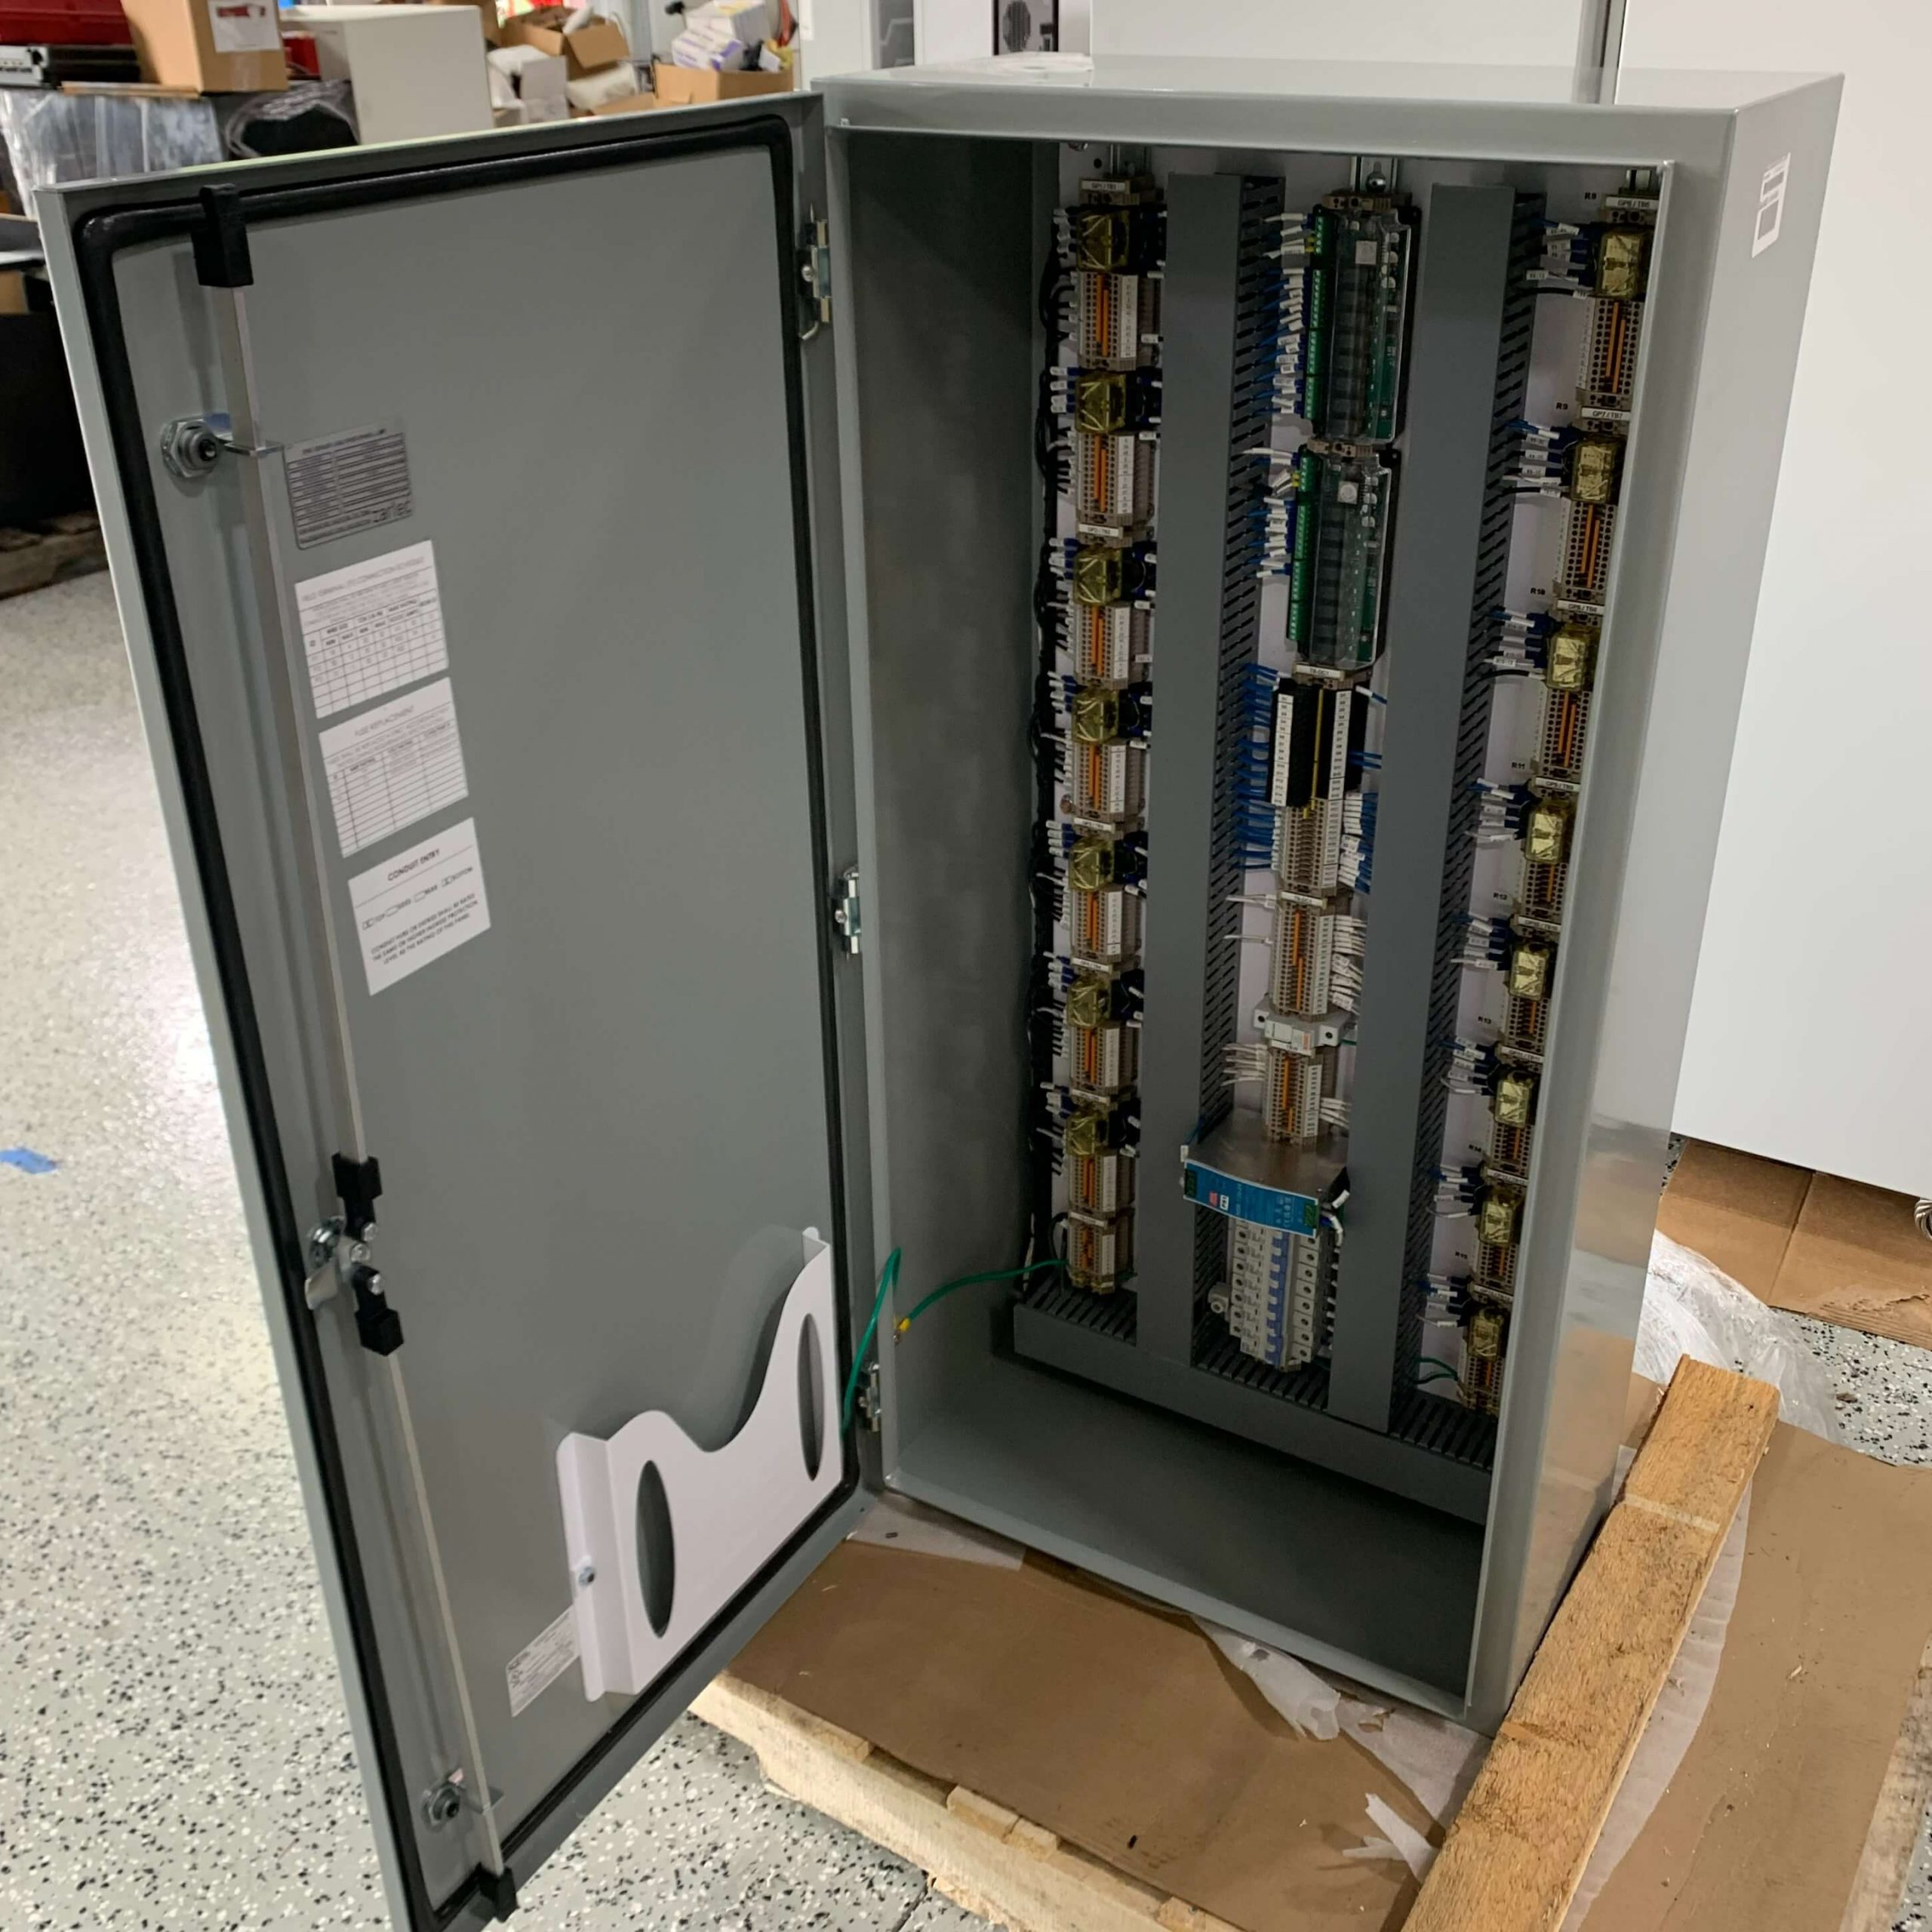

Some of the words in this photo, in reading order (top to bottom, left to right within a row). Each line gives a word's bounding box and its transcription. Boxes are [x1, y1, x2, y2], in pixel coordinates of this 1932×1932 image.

[1555, 402, 1568, 411] R9
[388, 860, 419, 880] CONDUIT
[420, 849, 440, 863] ENTRY
